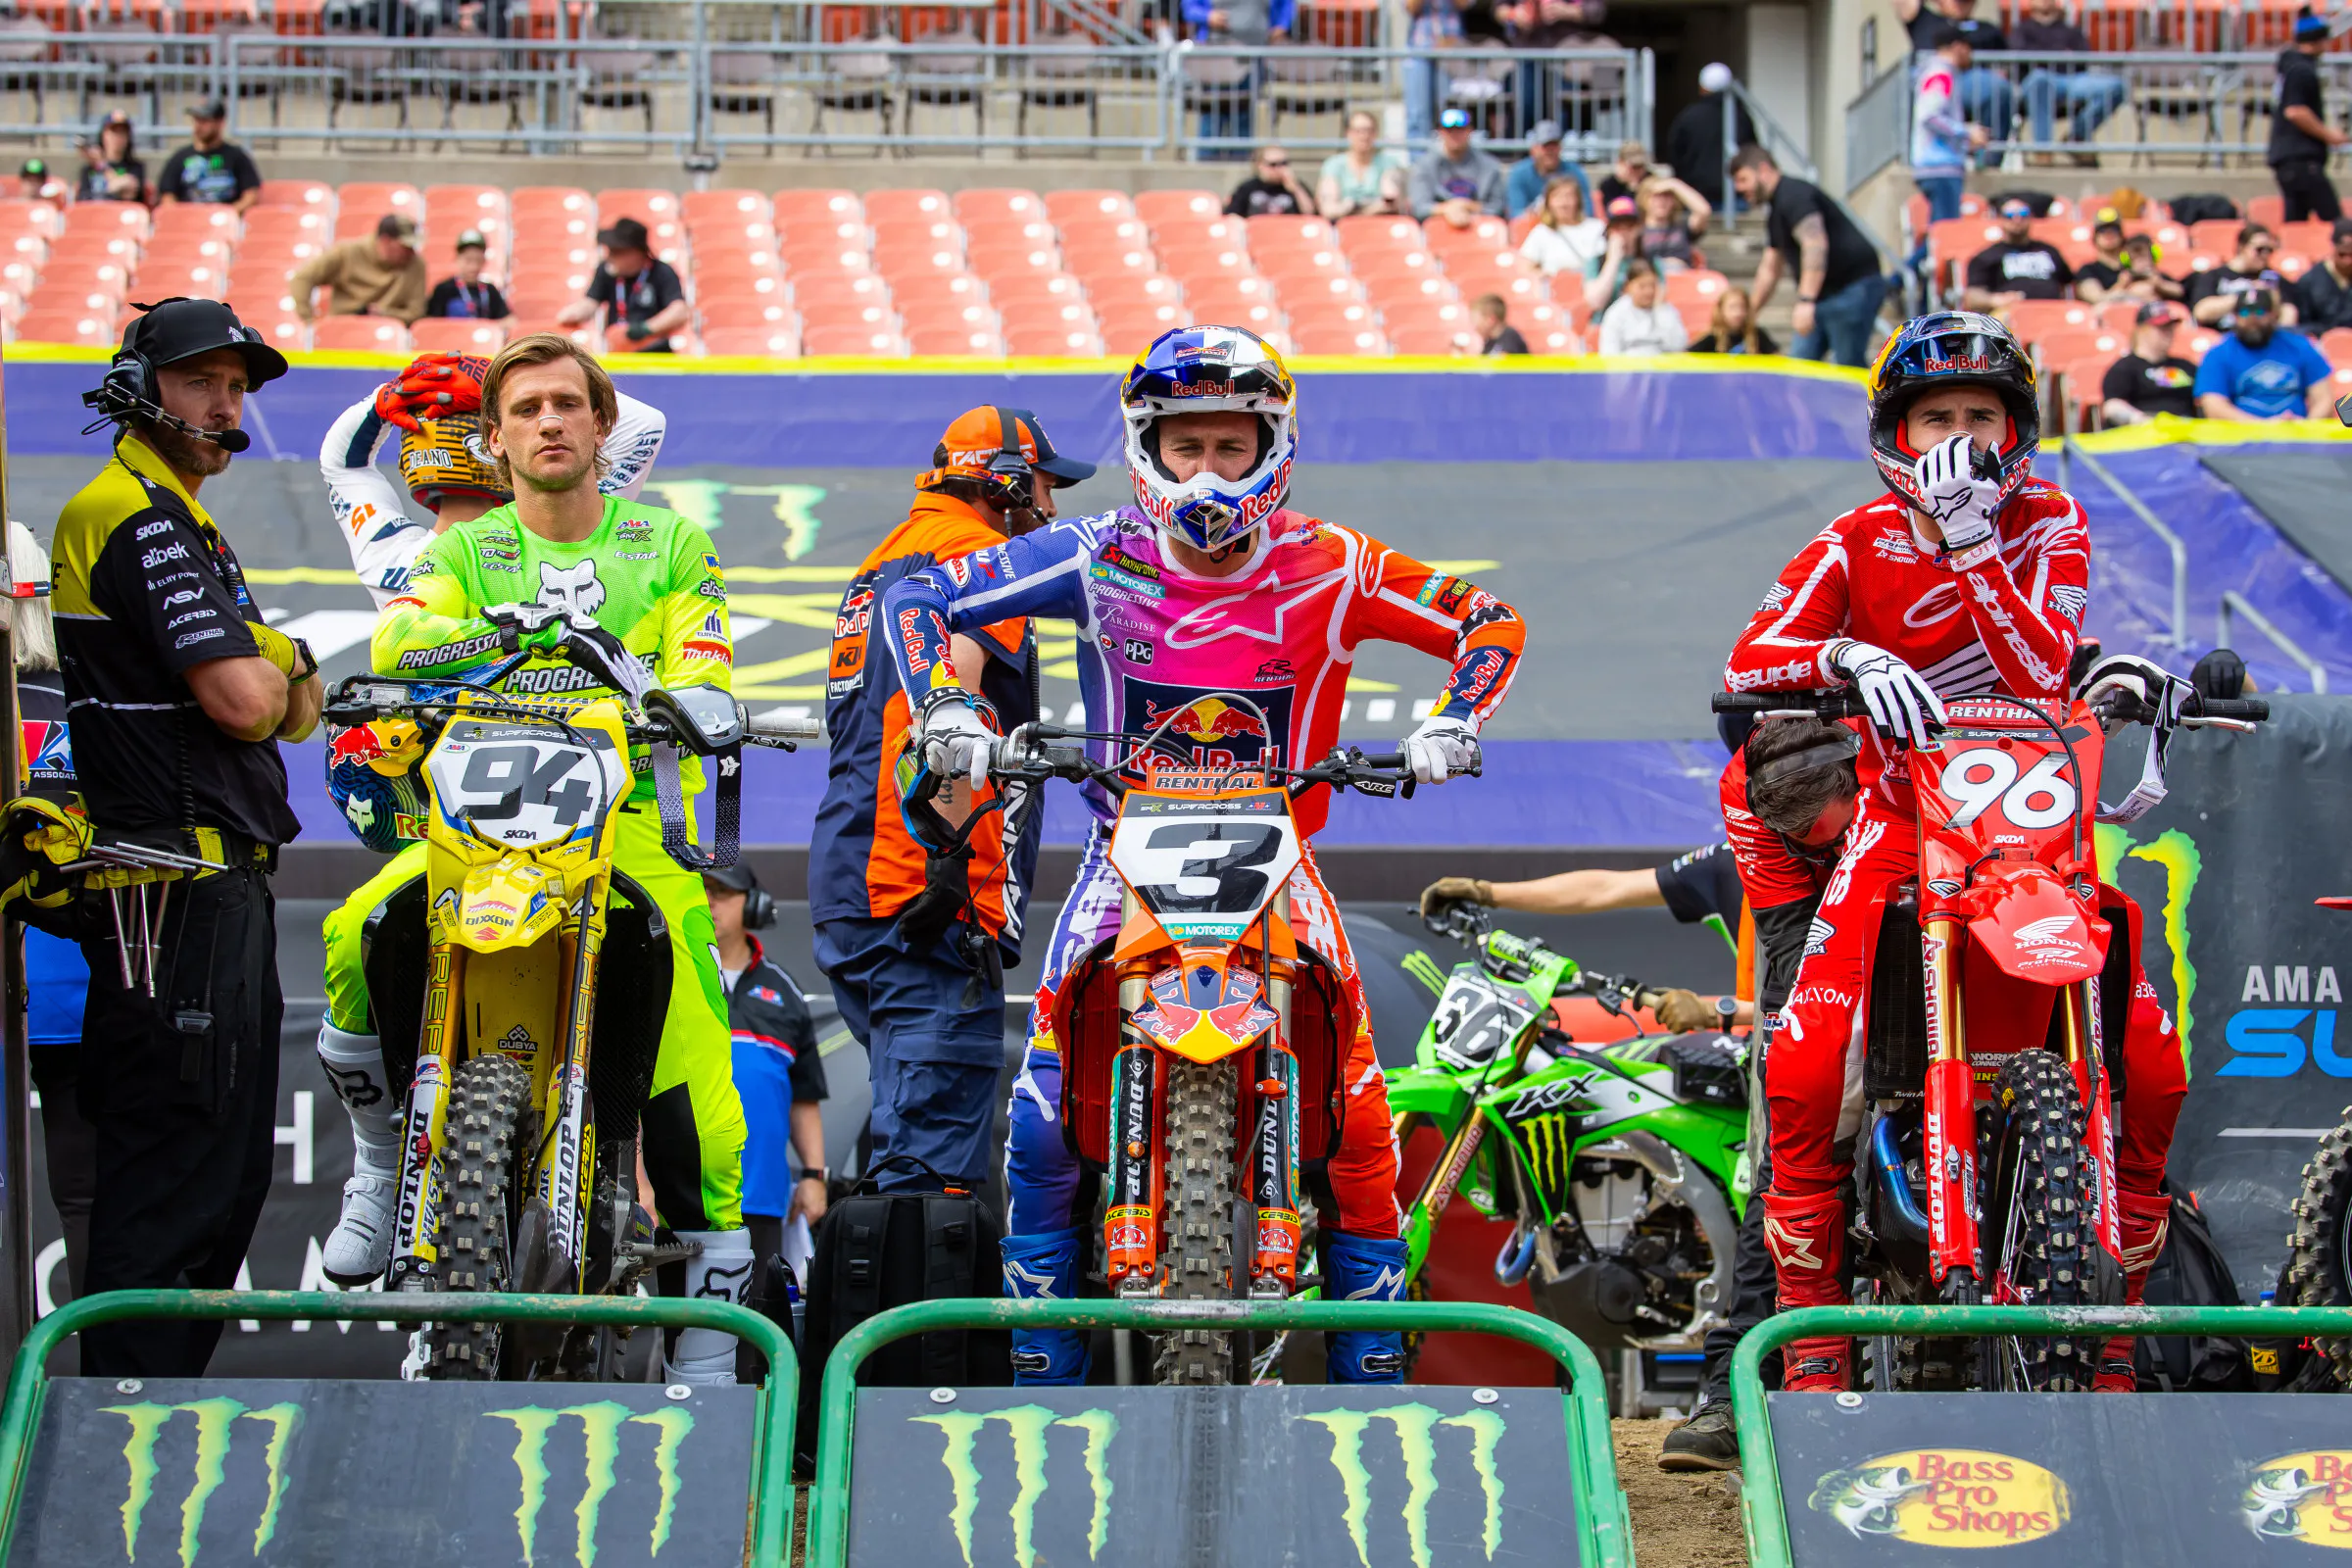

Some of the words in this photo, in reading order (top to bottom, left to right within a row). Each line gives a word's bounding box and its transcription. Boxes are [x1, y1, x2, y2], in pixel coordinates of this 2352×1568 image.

[1925, 356, 1955, 373] Red
[1958, 355, 1988, 370] Bull
[1172, 380, 1201, 396] Red
[1203, 378, 1235, 395] Bull
[135, 519, 174, 541] SKDA
[615, 550, 659, 561] ECSTAR
[1089, 582, 1161, 609] PROGRESSIVE
[1109, 570, 1162, 597] MOTOREX
[163, 586, 205, 611] ASV
[899, 608, 920, 643] Red
[905, 638, 930, 676] Bull
[1125, 641, 1152, 662] PPG
[491, 729, 567, 740] SUPERCROSS
[455, 746, 594, 826] 94
[1155, 777, 1260, 790] RENTHAL
[1354, 781, 1396, 794] ARC
[1940, 748, 2078, 830] 96
[503, 829, 538, 841] SKDA
[1993, 835, 2025, 844] SKDA
[1134, 823, 1283, 913] 3
[466, 914, 514, 927] DIXXON
[1185, 925, 1240, 936] MOTOREX
[2015, 938, 2084, 950] HONDA
[2044, 957, 2087, 969] Honda
[2241, 965, 2342, 1003] AMA
[1435, 988, 1525, 1062] 36
[499, 1039, 537, 1051] DUBYA
[1506, 1069, 1604, 1118] KX
[398, 1108, 429, 1249] DUNLOP
[556, 1123, 577, 1254] DUNLOP
[1928, 1112, 1945, 1244] DUNLOP
[2103, 1116, 2121, 1253] DUNLOP
[1916, 1454, 2014, 1482] Bass
[1928, 1481, 1999, 1506] Pro
[1929, 1504, 2053, 1539] Shops
